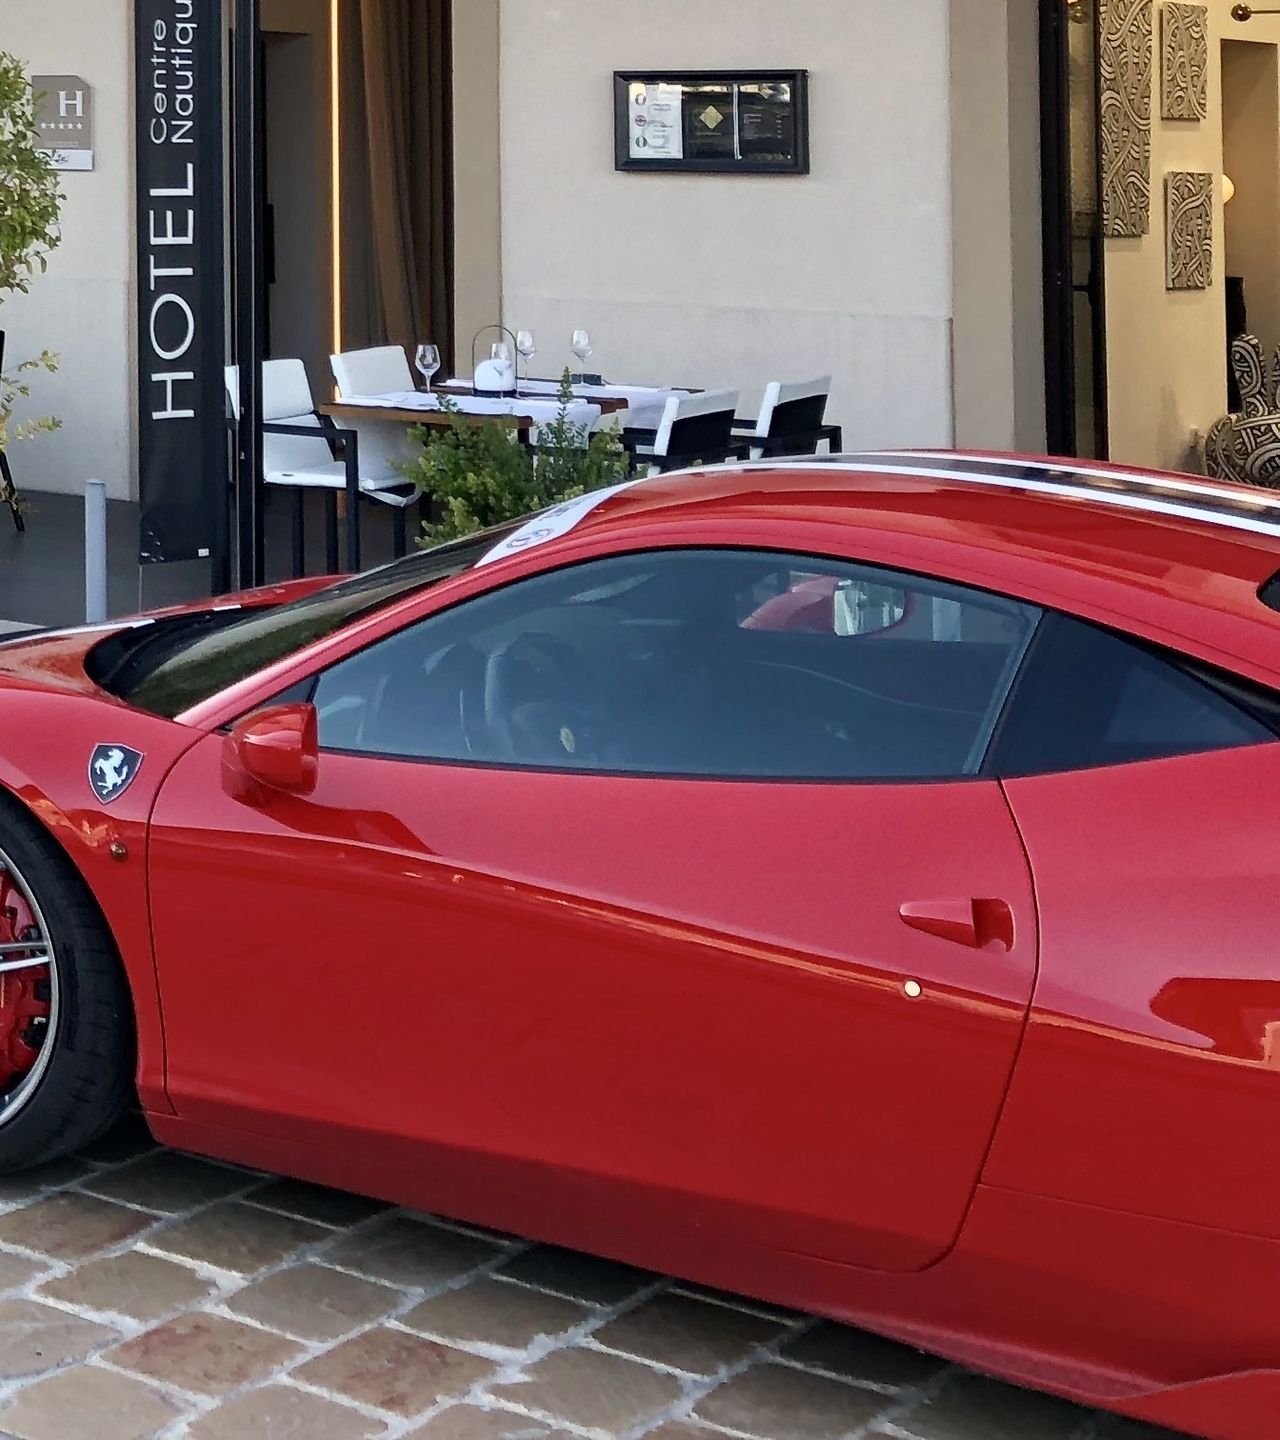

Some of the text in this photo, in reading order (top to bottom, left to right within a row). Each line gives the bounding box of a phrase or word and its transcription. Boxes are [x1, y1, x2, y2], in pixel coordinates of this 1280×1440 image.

[58, 90, 84, 117] H
[150, 19, 168, 145] Centre
[149, 162, 195, 420] HOTEL
